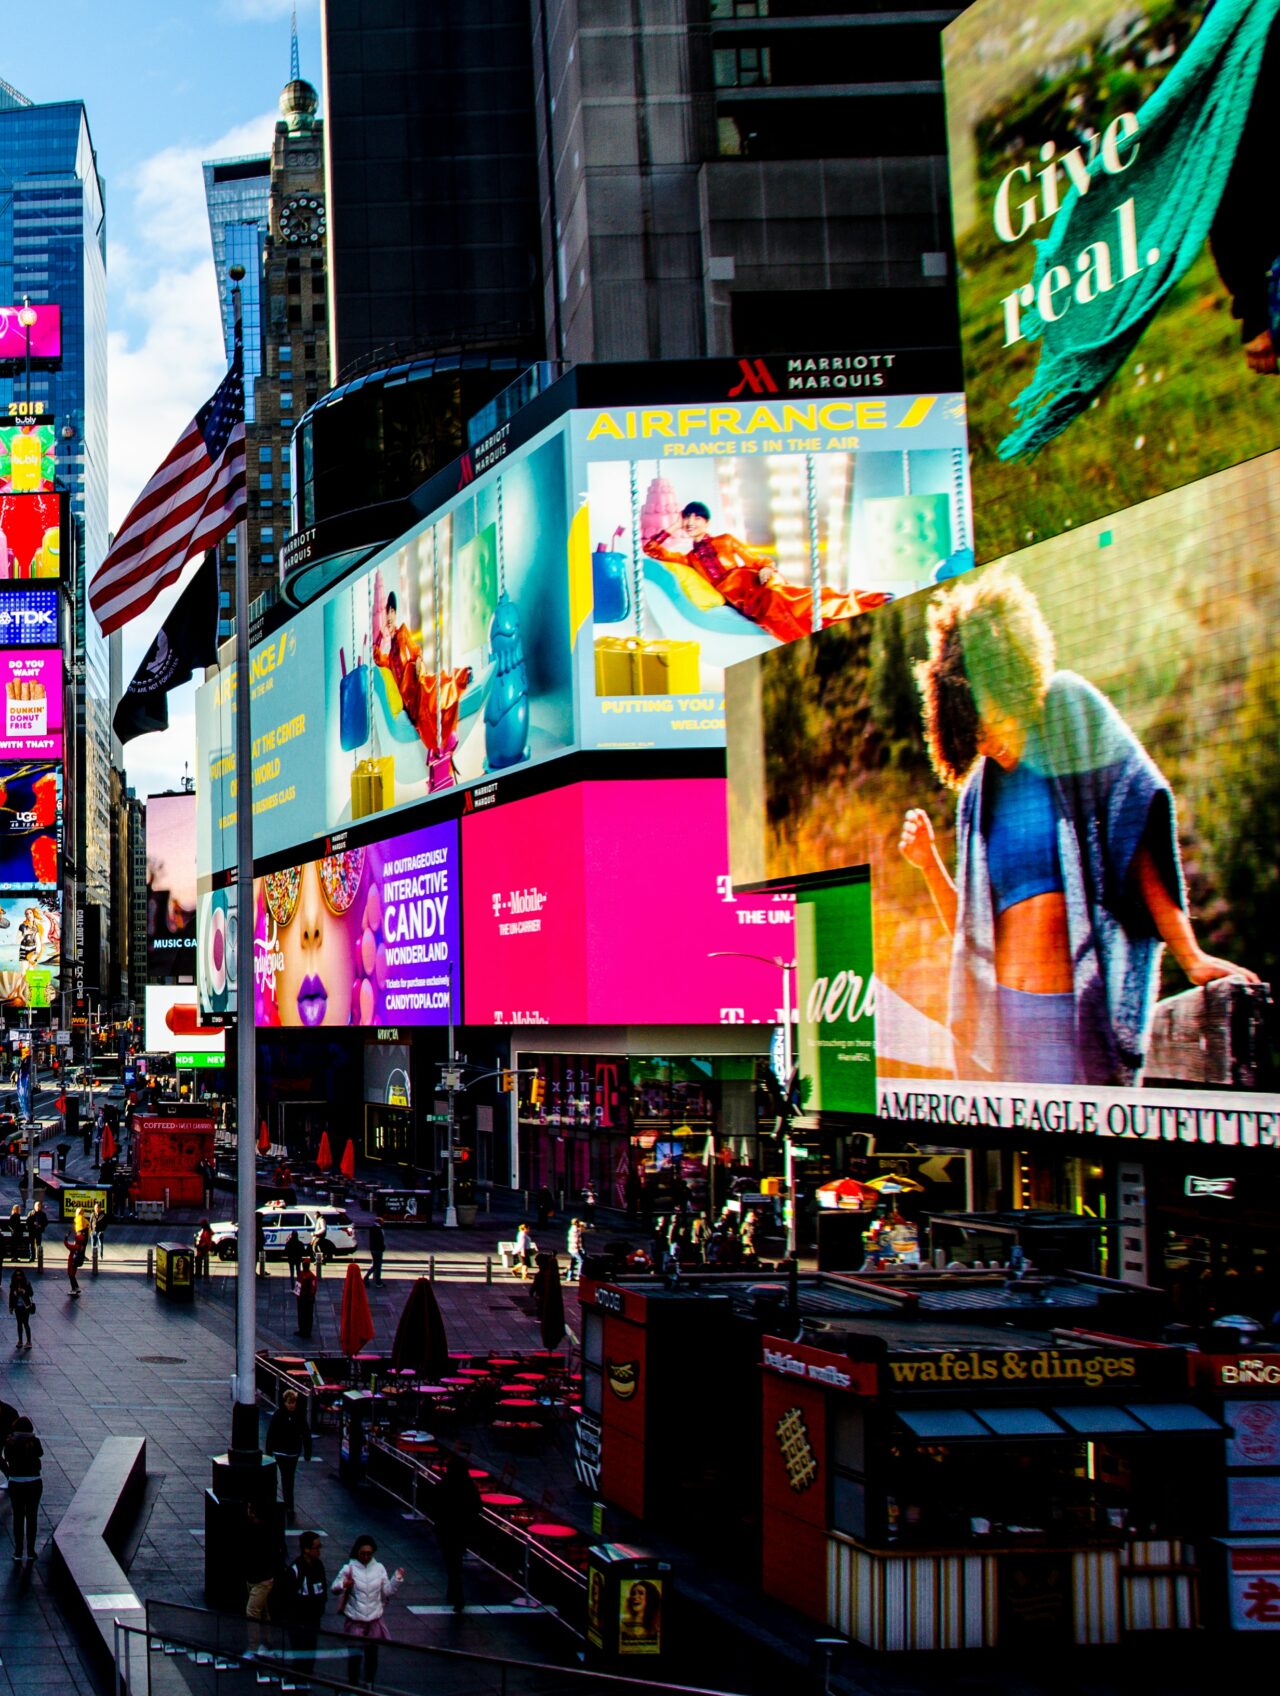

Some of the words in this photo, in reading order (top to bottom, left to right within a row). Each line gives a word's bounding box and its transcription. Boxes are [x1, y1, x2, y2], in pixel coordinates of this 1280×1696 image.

[993, 111, 1141, 243] Give
[1000, 197, 1160, 349] real.
[787, 355, 896, 372] MARRIOTT
[787, 373, 884, 390] MARQUIS
[8, 402, 44, 416] 2018
[475, 422, 511, 459] MARRIOTT
[663, 441, 736, 457] FRANCE
[741, 440, 757, 453] IS
[763, 439, 782, 452] IN
[787, 438, 821, 452] THE
[827, 436, 859, 450] AIR
[475, 442, 507, 474] MARQUIS
[283, 528, 316, 555] MARRIOTT
[284, 546, 312, 569] MARQUIS
[11, 610, 53, 625] TDK
[8, 660, 23, 668] DO
[25, 660, 45, 668] YOU
[12, 668, 41, 677] WANT
[10, 706, 45, 715] DUNKIN'
[601, 699, 673, 714] PUTTING
[678, 698, 715, 711] YOU
[10, 714, 39, 722] DONUT
[10, 722, 33, 730] FRIES
[262, 733, 275, 751] THE
[276, 714, 306, 746] CENTER
[26, 740, 55, 748] THAT?
[255, 758, 280, 784] WORLD
[474, 782, 498, 797] MARRIOTT
[474, 794, 496, 808] MARQUIS
[16, 812, 37, 822] UGG
[383, 863, 392, 876] AN
[393, 847, 448, 872] OUTRAGEOUSLY
[383, 870, 448, 902] INTERACTIVE
[384, 895, 448, 942] CANDY
[737, 910, 765, 924] THE
[499, 923, 510, 936] THE
[153, 939, 182, 949] MUSIC
[385, 942, 448, 965] WONDERLAND
[386, 979, 400, 989] Tickets
[407, 978, 425, 989] purchase
[426, 975, 450, 989] exclusively
[386, 993, 450, 1011] CANDYTOPIA.COM
[880, 1092, 1004, 1127] AMERICAN
[1012, 1098, 1097, 1136] EAGLE
